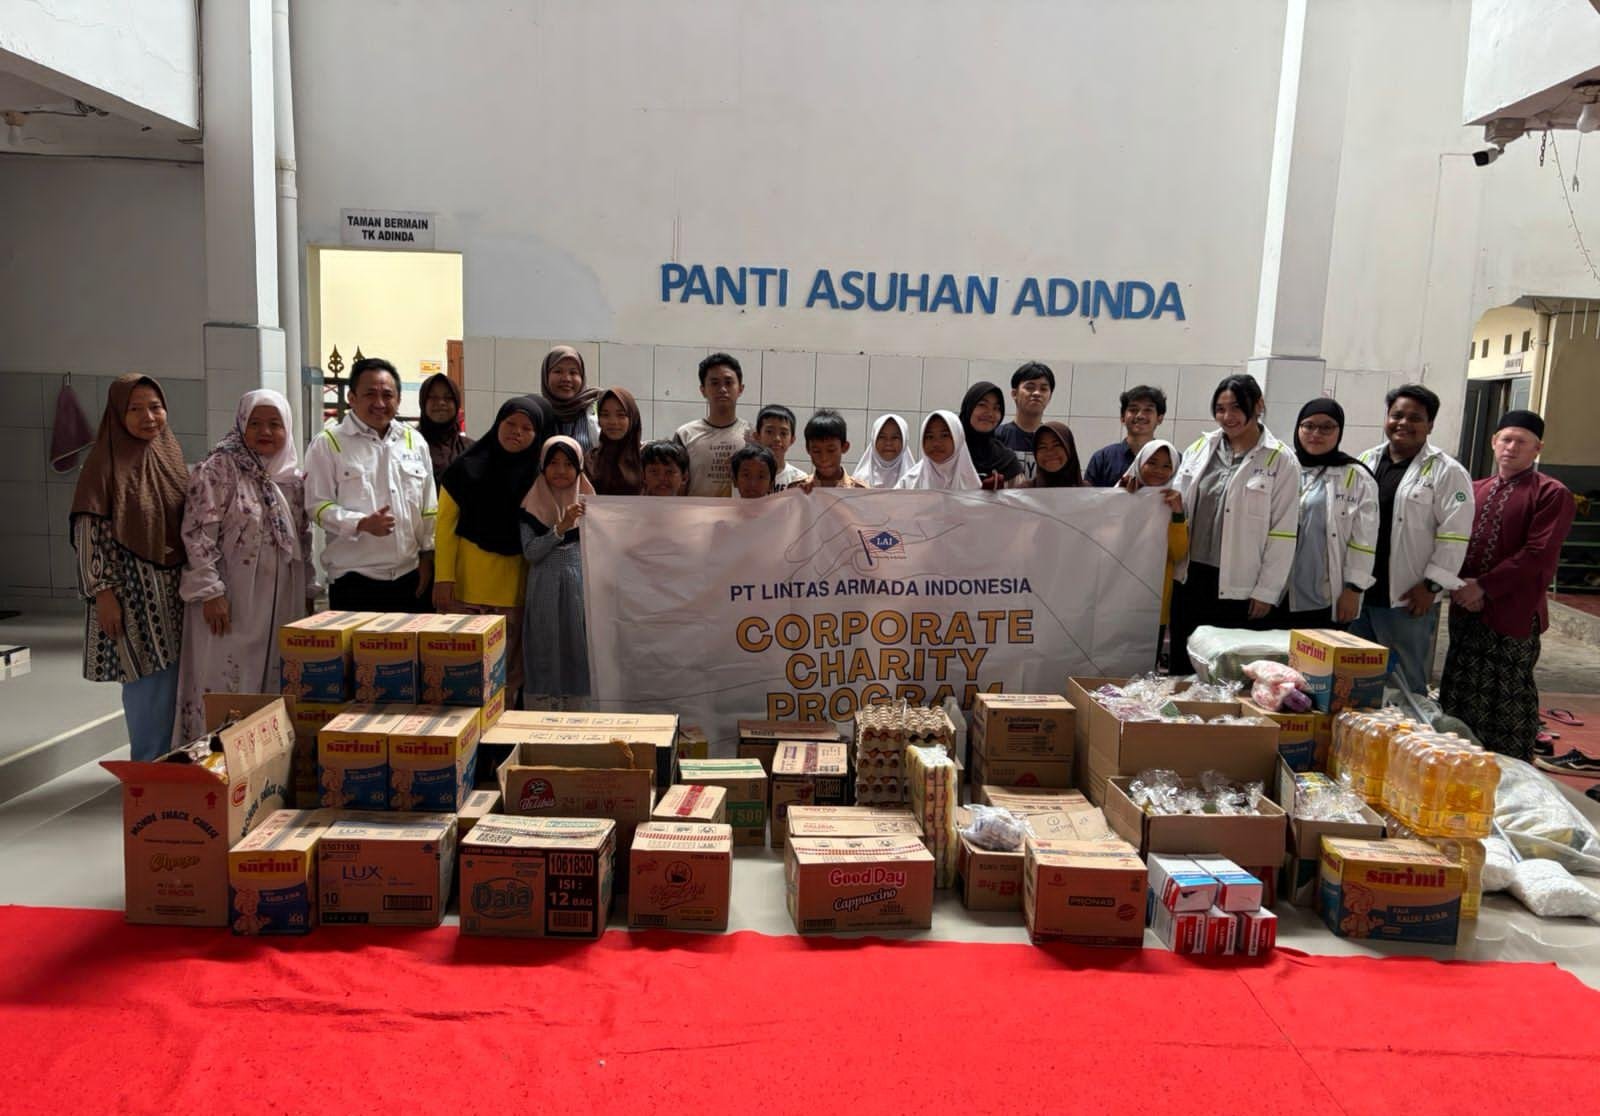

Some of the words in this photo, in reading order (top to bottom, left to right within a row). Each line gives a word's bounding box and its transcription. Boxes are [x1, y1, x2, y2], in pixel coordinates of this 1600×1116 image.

[347, 215, 381, 228] TAMAN
[384, 218, 429, 230] BERMAIN
[362, 229, 376, 241] TK
[378, 230, 415, 242] ADINDA
[661, 263, 789, 307] PANTI
[805, 269, 999, 315] ASUHAN
[1012, 277, 1187, 321] ADINDA
[876, 537, 893, 545] LAI
[730, 585, 754, 602] PT
[761, 579, 830, 601] LINTAS
[834, 578, 919, 598] ARMADA
[924, 576, 1033, 597] INDONESIA
[735, 608, 1035, 653] CORPORATE
[286, 635, 336, 649] sarimi
[359, 637, 409, 650] sarimi
[427, 638, 477, 652] sarimi
[1296, 640, 1327, 663] sarimi
[1340, 653, 1384, 665] sarimi
[785, 647, 989, 689] CHARITY
[766, 683, 1004, 723] PROGRAM
[1280, 721, 1308, 732] rimi
[326, 739, 381, 753] sarimi
[395, 741, 450, 756] sarimi
[238, 858, 299, 873] sarimi
[551, 854, 593, 874] 1061830
[342, 864, 383, 881] LUX
[829, 868, 872, 887] Good
[873, 867, 906, 888] Day
[1365, 867, 1447, 888] sarimi
[559, 879, 576, 890] ISI
[325, 892, 339, 905] 10
[472, 880, 532, 907] Daia
[550, 892, 569, 906] 12
[833, 887, 898, 912] Cappuccino
